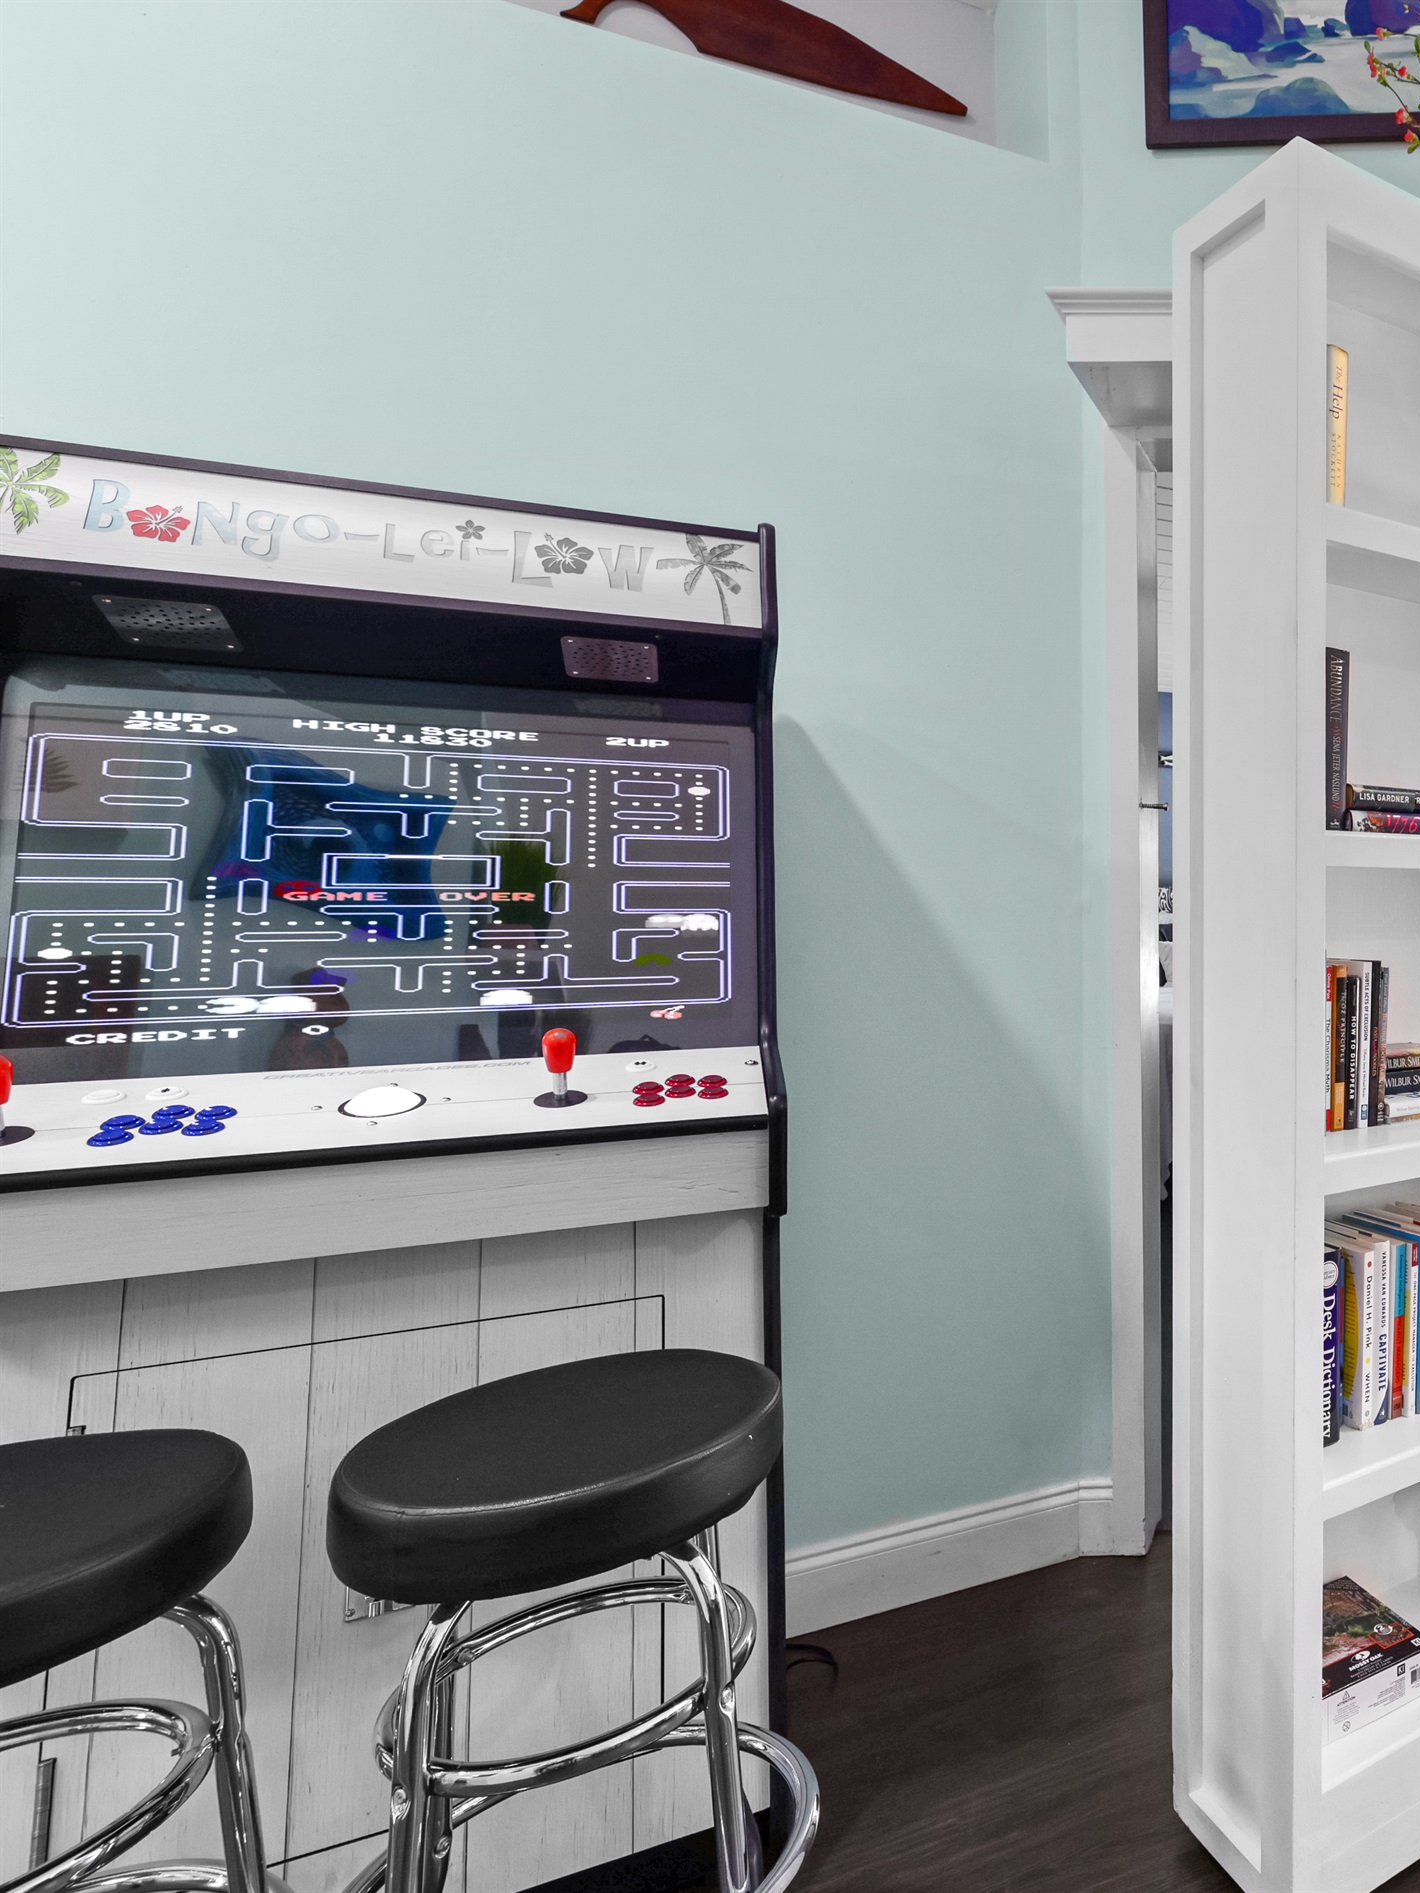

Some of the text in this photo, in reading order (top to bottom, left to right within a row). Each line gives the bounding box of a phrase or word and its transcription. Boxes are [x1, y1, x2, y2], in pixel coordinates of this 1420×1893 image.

[1329, 365, 1343, 420] The Help
[1330, 655, 1345, 723] ABUNDANCE
[128, 710, 211, 722] 1UP
[123, 720, 238, 734] 2810
[292, 719, 539, 742] HIGH SCORE
[374, 733, 492, 747] 11830
[605, 737, 670, 748] 2UP
[1333, 736, 1342, 752] SENA
[1332, 772, 1341, 802] NASLUND
[1359, 792, 1375, 801] LISA
[1377, 794, 1410, 803] GARDNER
[1386, 814, 1420, 833] 1776
[282, 888, 537, 903] GAME OVER
[1364, 1004, 1369, 1012] OF
[65, 1024, 330, 1046] CREDIT 0
[1351, 1039, 1356, 1050] TO
[1385, 1076, 1411, 1088] WILBUR
[1323, 1291, 1337, 1341] Desk
[1366, 1312, 1373, 1324] H.
[1364, 1327, 1373, 1349] Pink
[1378, 1333, 1388, 1391] CAPTIVATE
[1323, 1346, 1336, 1439] Dictionary
[1364, 1372, 1372, 1403] WHEN
[1348, 1659, 1370, 1671] MOSSY
[1370, 1652, 1384, 1662] OAK
